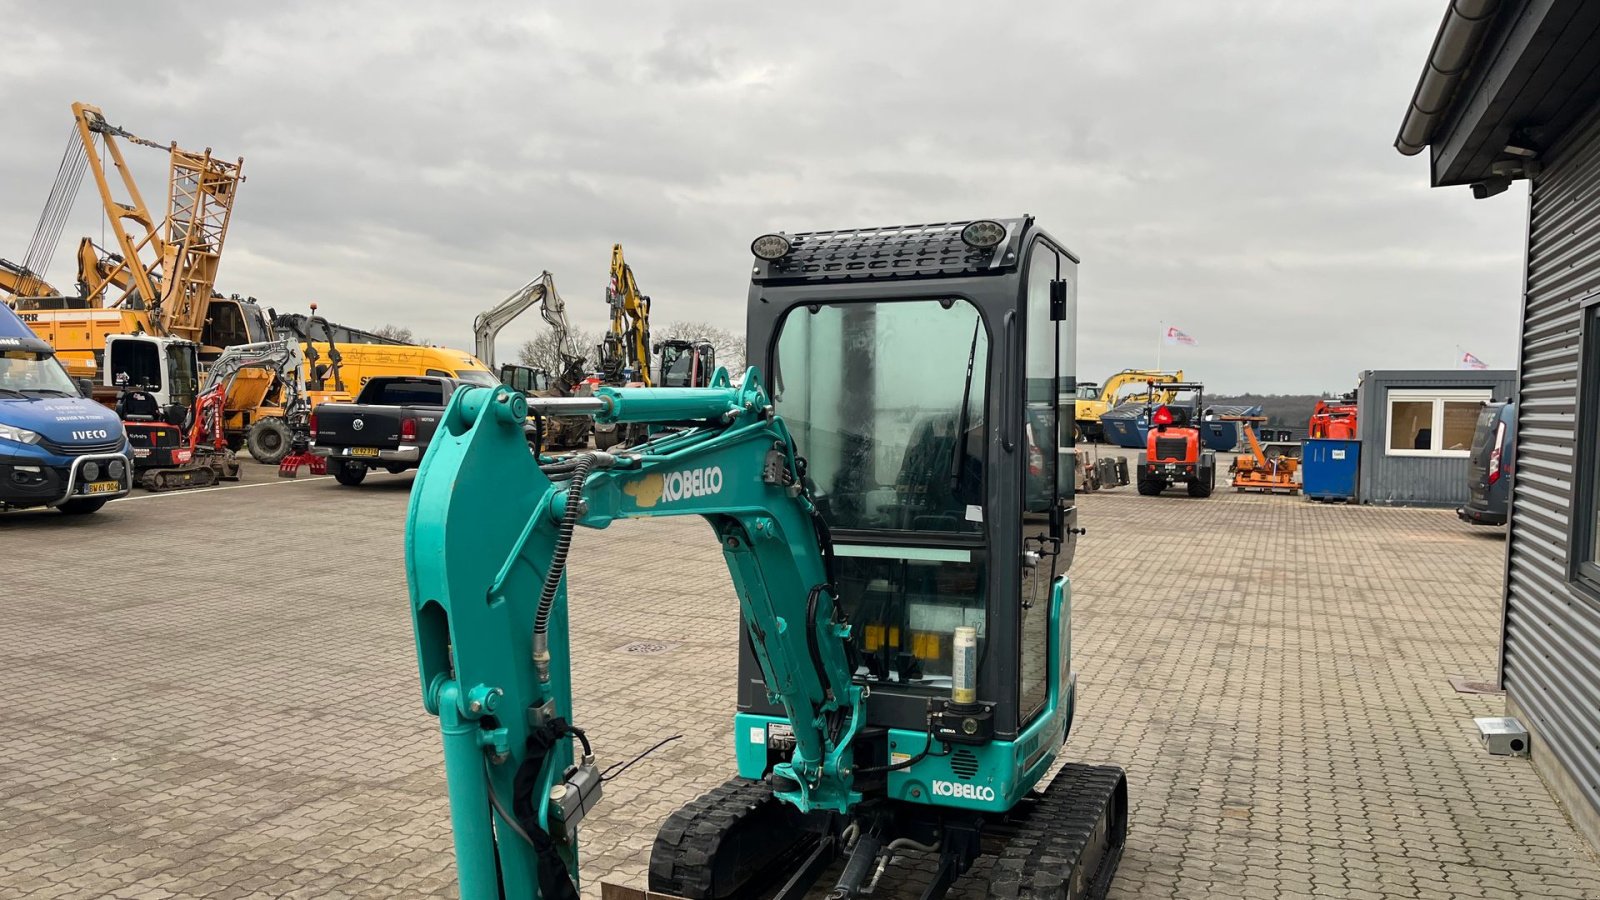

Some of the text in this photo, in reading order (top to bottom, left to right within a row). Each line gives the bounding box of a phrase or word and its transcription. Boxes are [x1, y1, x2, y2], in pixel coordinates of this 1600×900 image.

[72, 429, 107, 440] IVECO
[662, 466, 723, 503] KOBELCO
[932, 779, 995, 801] KOBELCO
